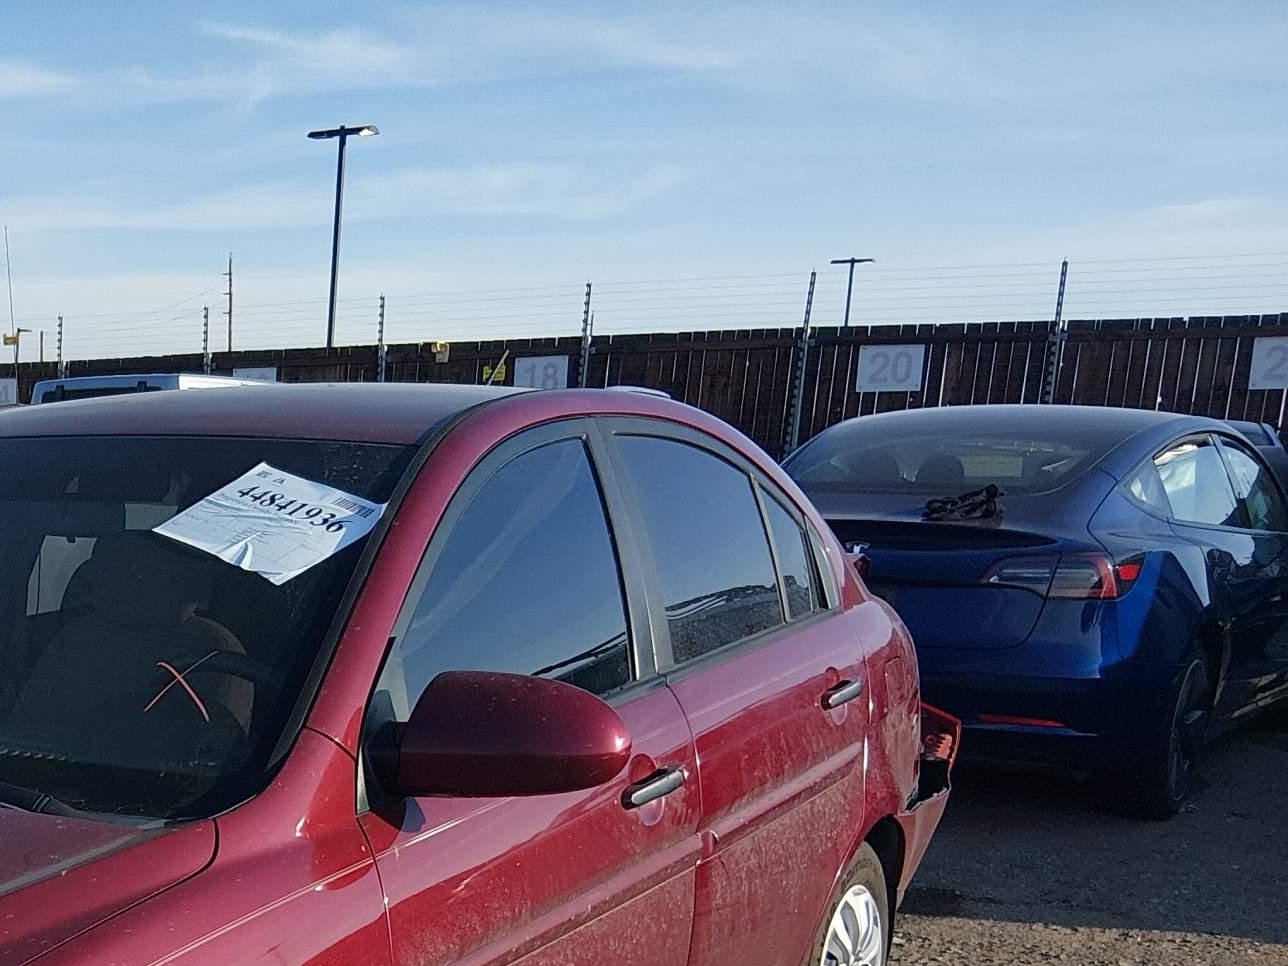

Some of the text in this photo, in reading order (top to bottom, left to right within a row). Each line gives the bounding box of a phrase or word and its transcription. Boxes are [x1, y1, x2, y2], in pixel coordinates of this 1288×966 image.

[524, 362, 559, 388] 18
[868, 351, 913, 384] 20
[236, 485, 353, 534] 44841936
